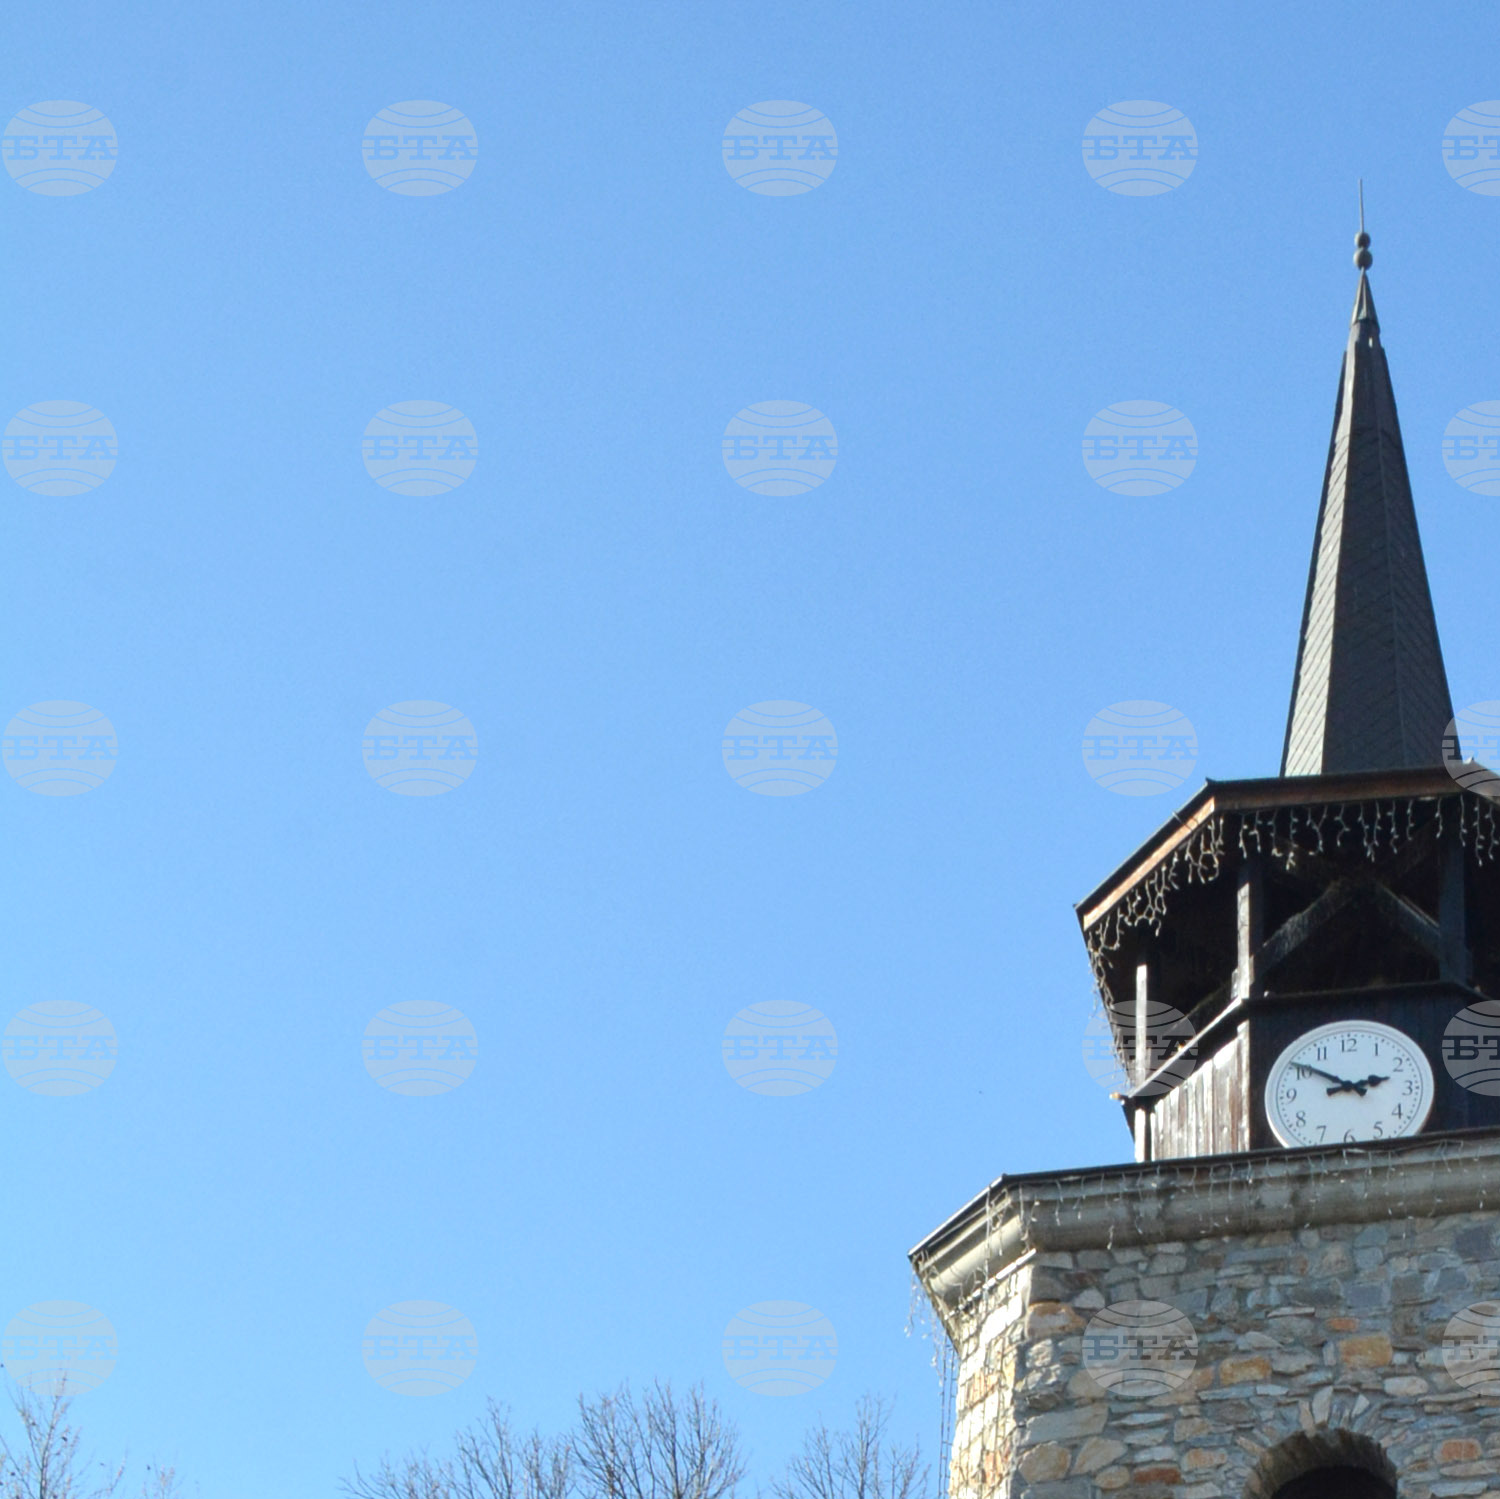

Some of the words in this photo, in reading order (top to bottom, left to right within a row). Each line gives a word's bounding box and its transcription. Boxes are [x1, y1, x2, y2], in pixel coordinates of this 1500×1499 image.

[1341, 1038, 1357, 1053] 12
[1373, 1043, 1379, 1057] 1
[1316, 1047, 1328, 1061] 11
[1392, 1057, 1404, 1073] 2
[1286, 1088, 1297, 1104] 9
[1402, 1080, 1413, 1097] 3
[1391, 1103, 1403, 1119] 4
[1295, 1111, 1306, 1128] 8
[1316, 1125, 1327, 1142] 7
[1373, 1121, 1383, 1139] 5
